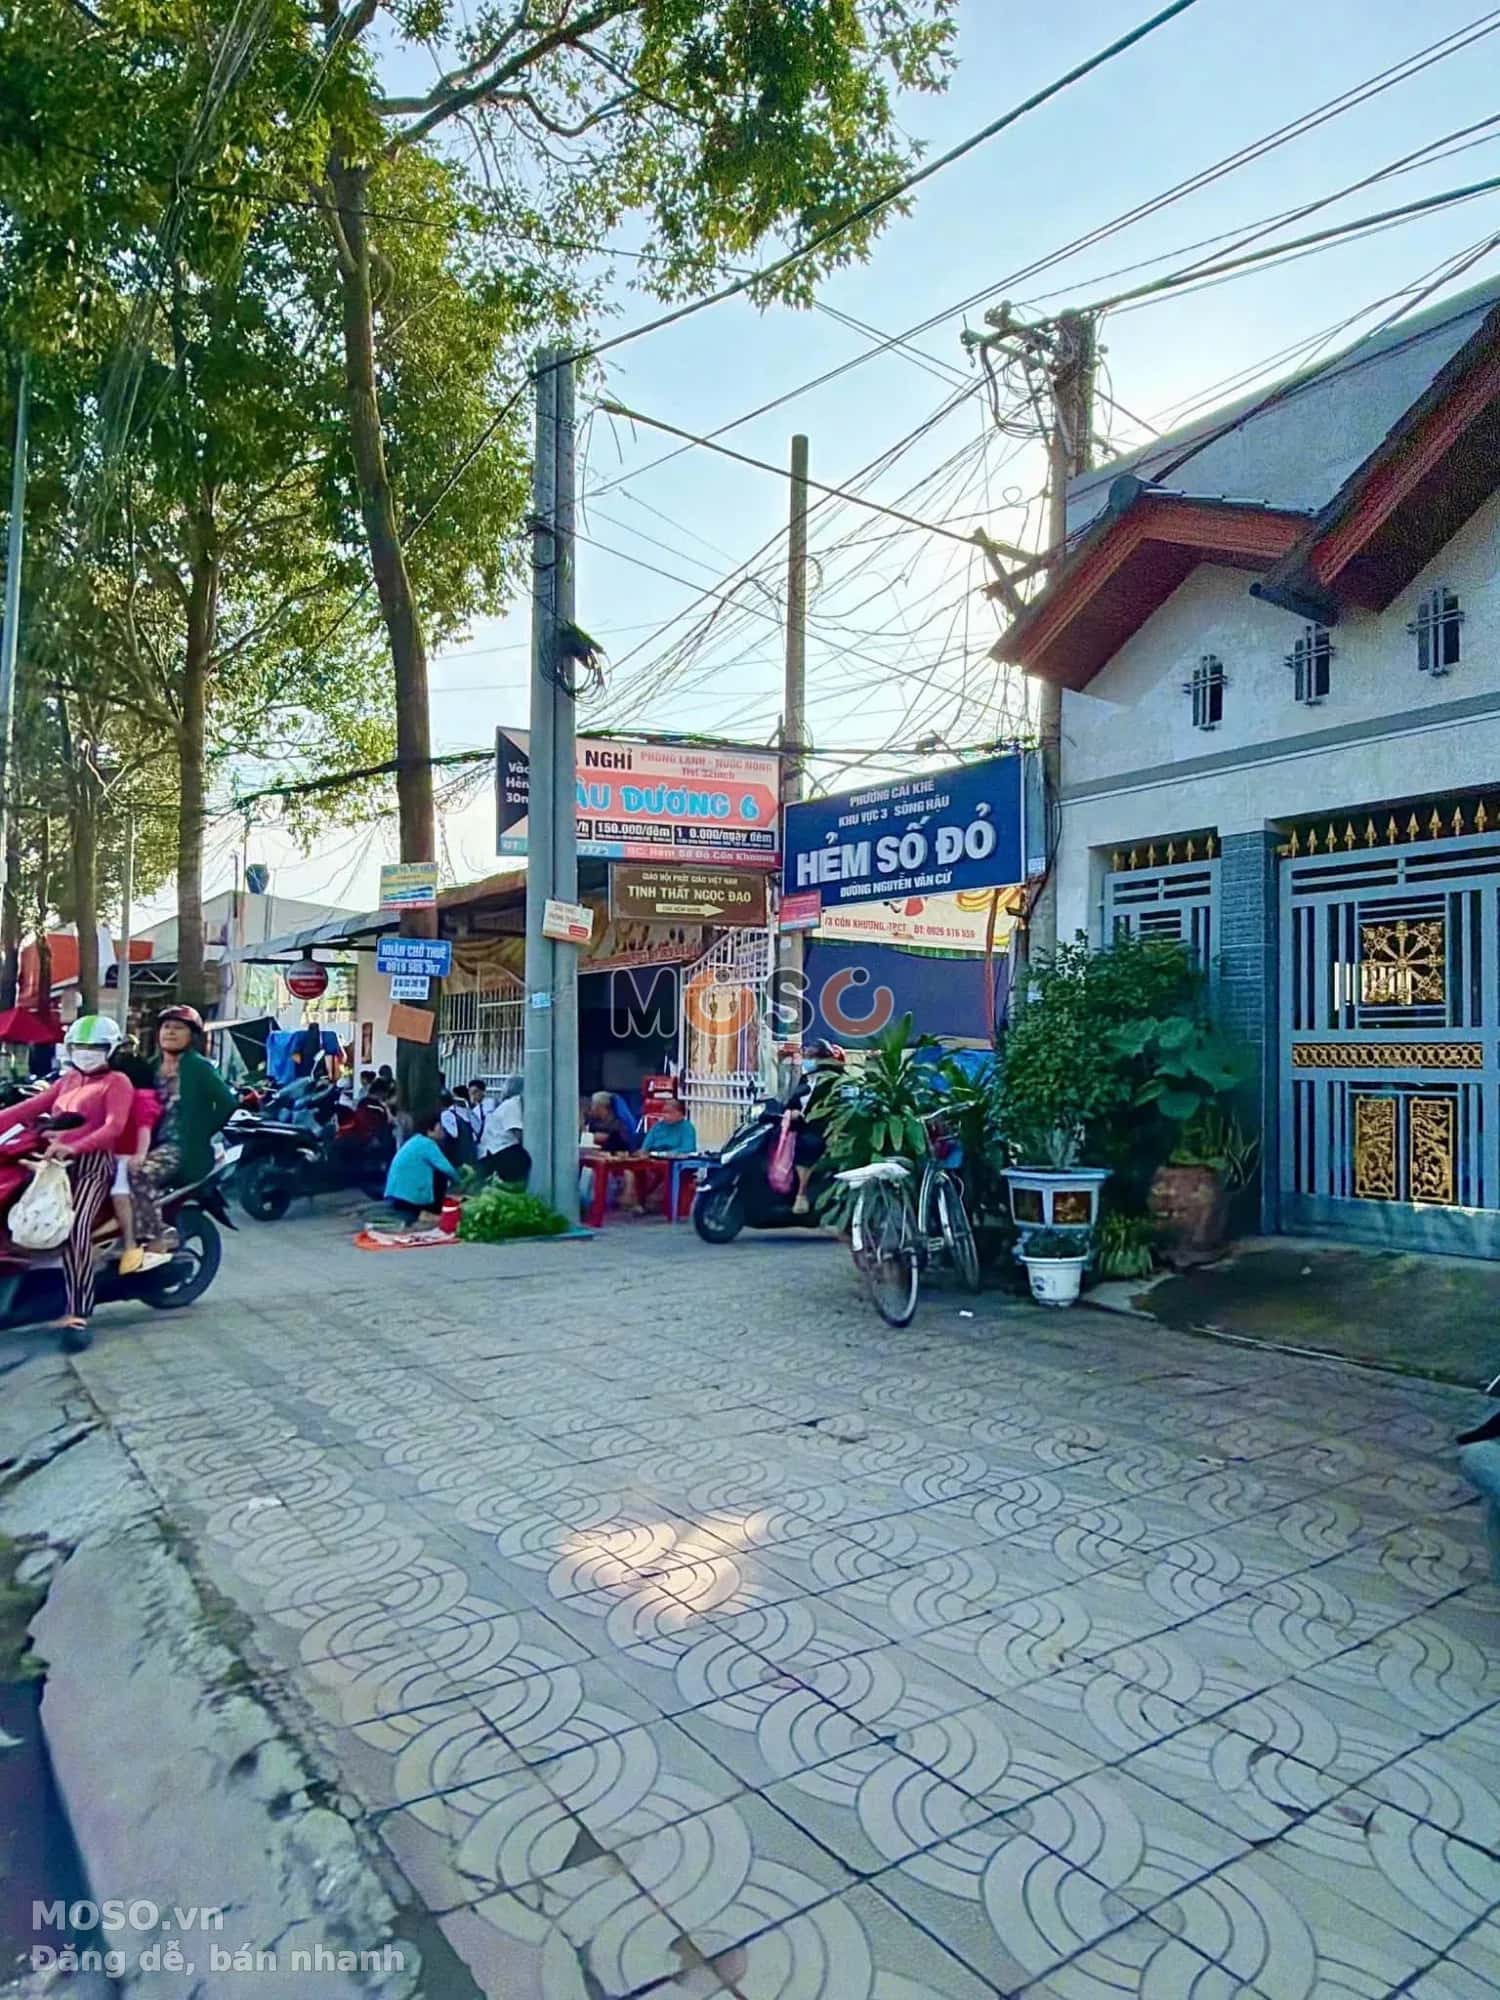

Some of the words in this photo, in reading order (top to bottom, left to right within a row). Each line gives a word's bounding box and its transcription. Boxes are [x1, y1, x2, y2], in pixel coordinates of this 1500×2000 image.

[585, 747, 632, 770] NGHỈ
[740, 793, 760, 821] 6
[849, 787, 890, 807] PHƯỜNG
[838, 813, 859, 828] KHU
[861, 810, 879, 826] VỰC
[881, 808, 888, 820] 3
[926, 794, 950, 813] HẬU
[797, 831, 870, 886] HẺM
[877, 815, 928, 873] SỐ
[936, 802, 996, 865] ĐỎ
[660, 884, 690, 899] THẤT
[694, 888, 725, 904] NGỌC
[728, 890, 751, 905] ĐẠO
[873, 872, 912, 894] NGUYỄN
